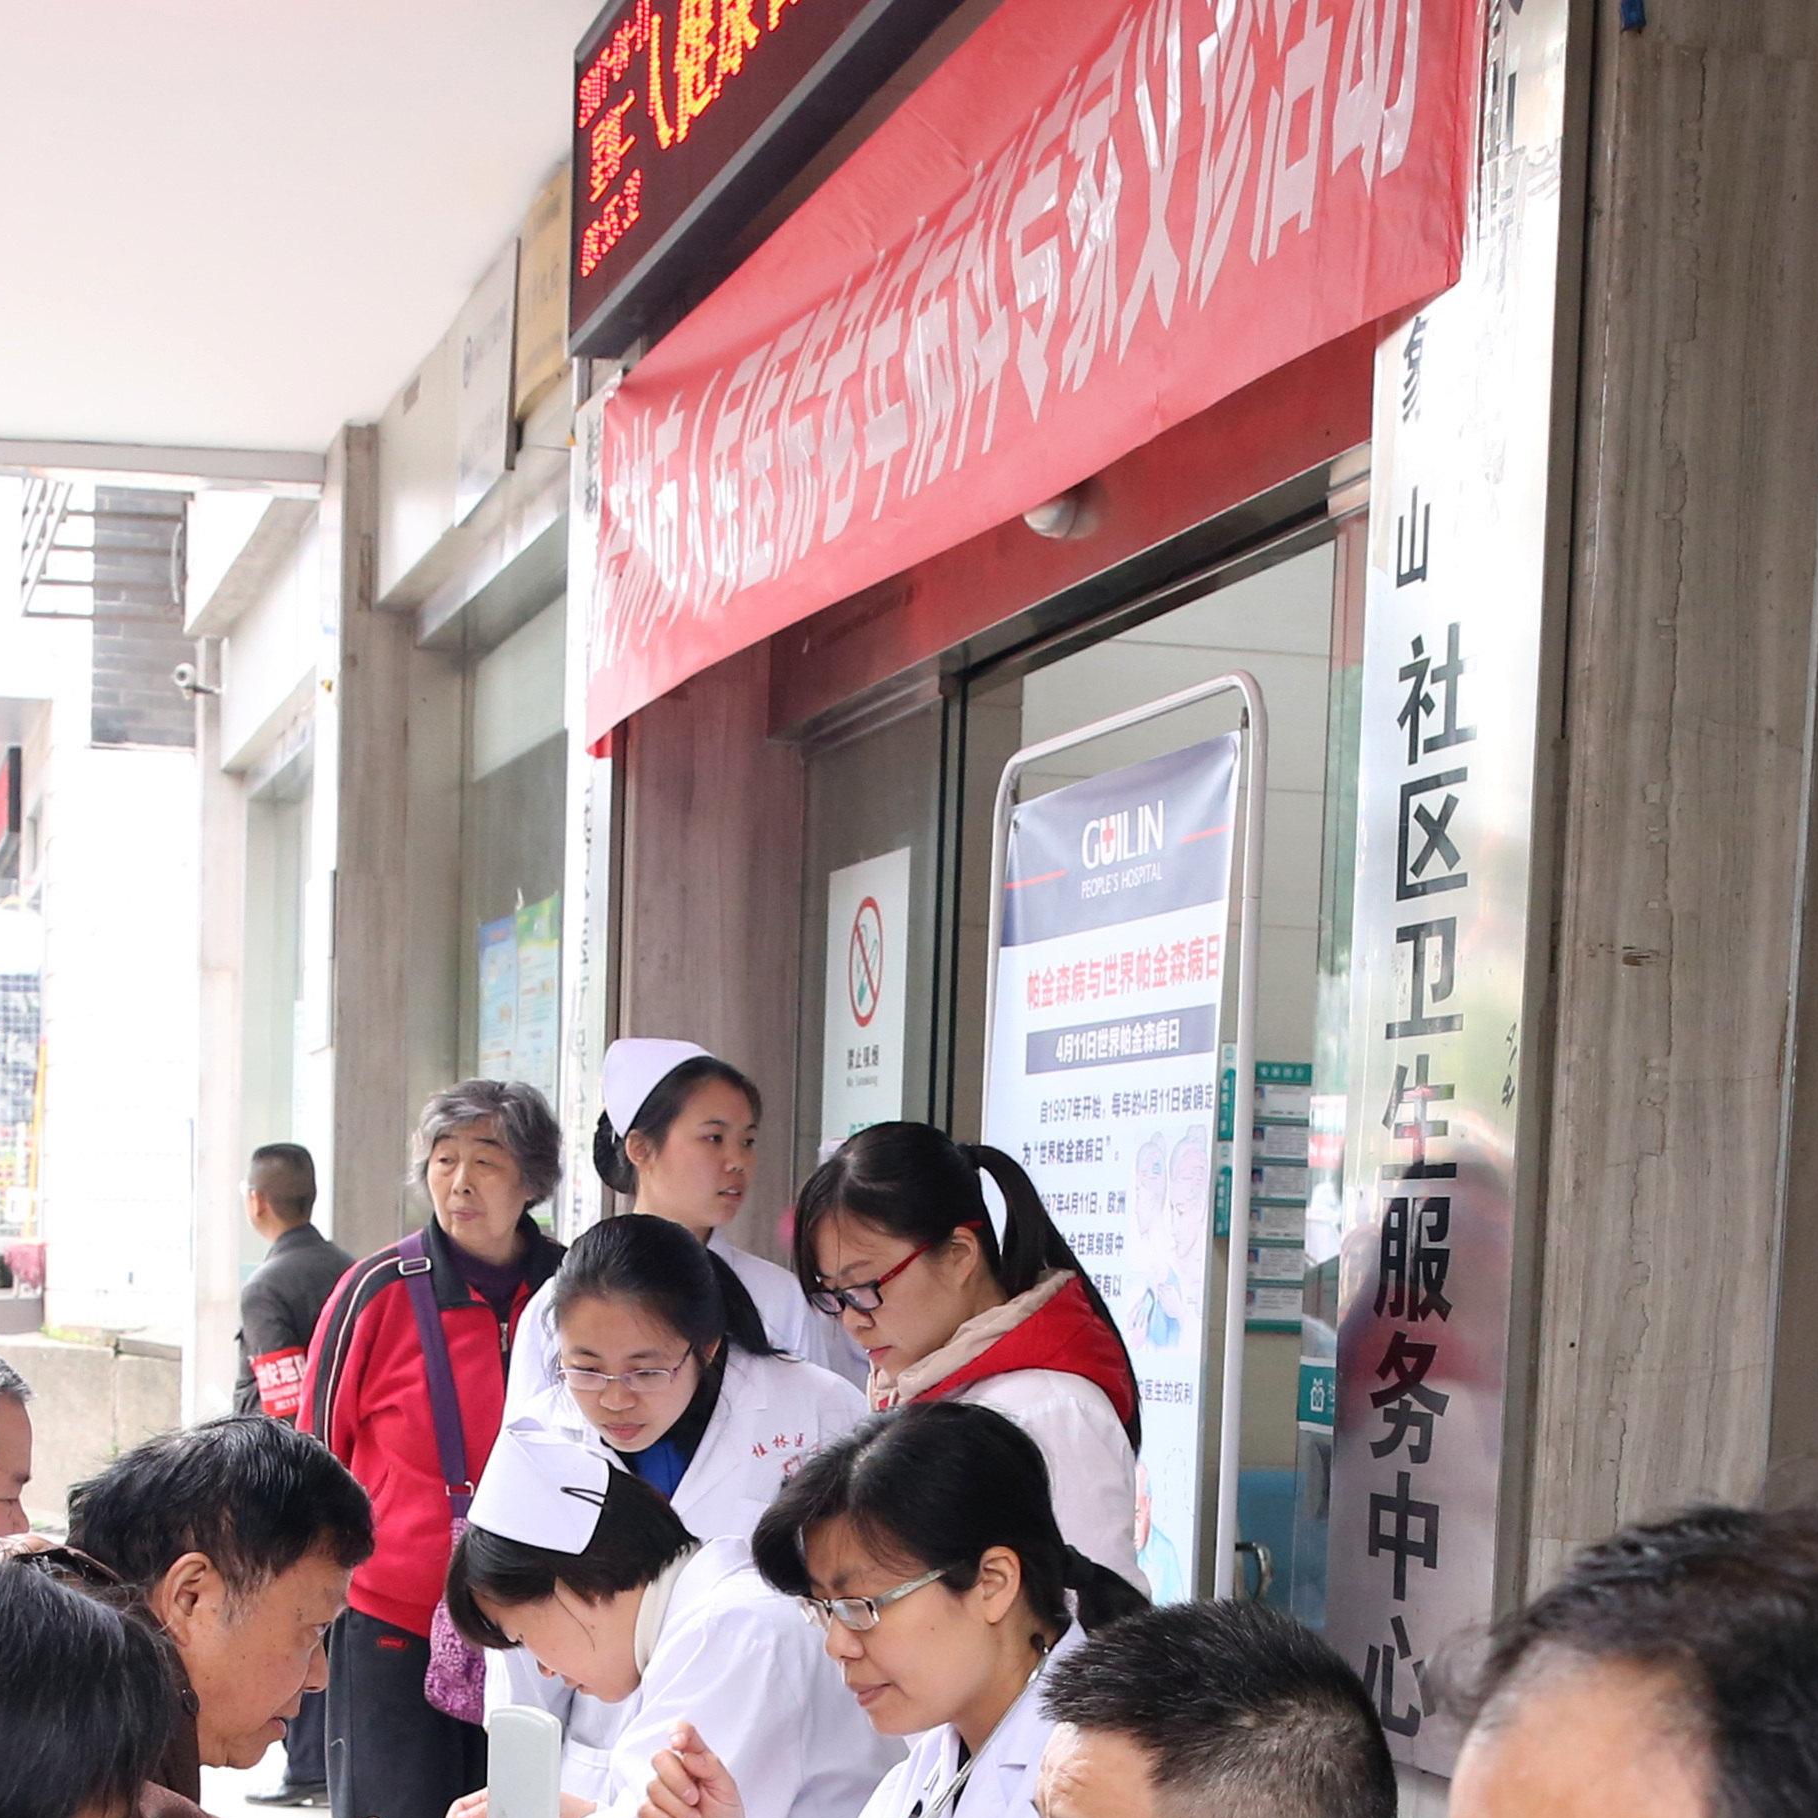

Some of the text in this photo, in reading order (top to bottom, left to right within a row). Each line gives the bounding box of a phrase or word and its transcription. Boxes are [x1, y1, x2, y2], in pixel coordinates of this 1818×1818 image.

[1081, 799, 1164, 870] GUILIN
[1121, 862, 1163, 890] HOSPITAL
[1027, 933, 1220, 1011] 帕金森病与世界帕金森病日
[1055, 1017, 1180, 1063] 4月11日世界帕金森病日
[1363, 622, 1480, 1738] 社区卫生服务中心
